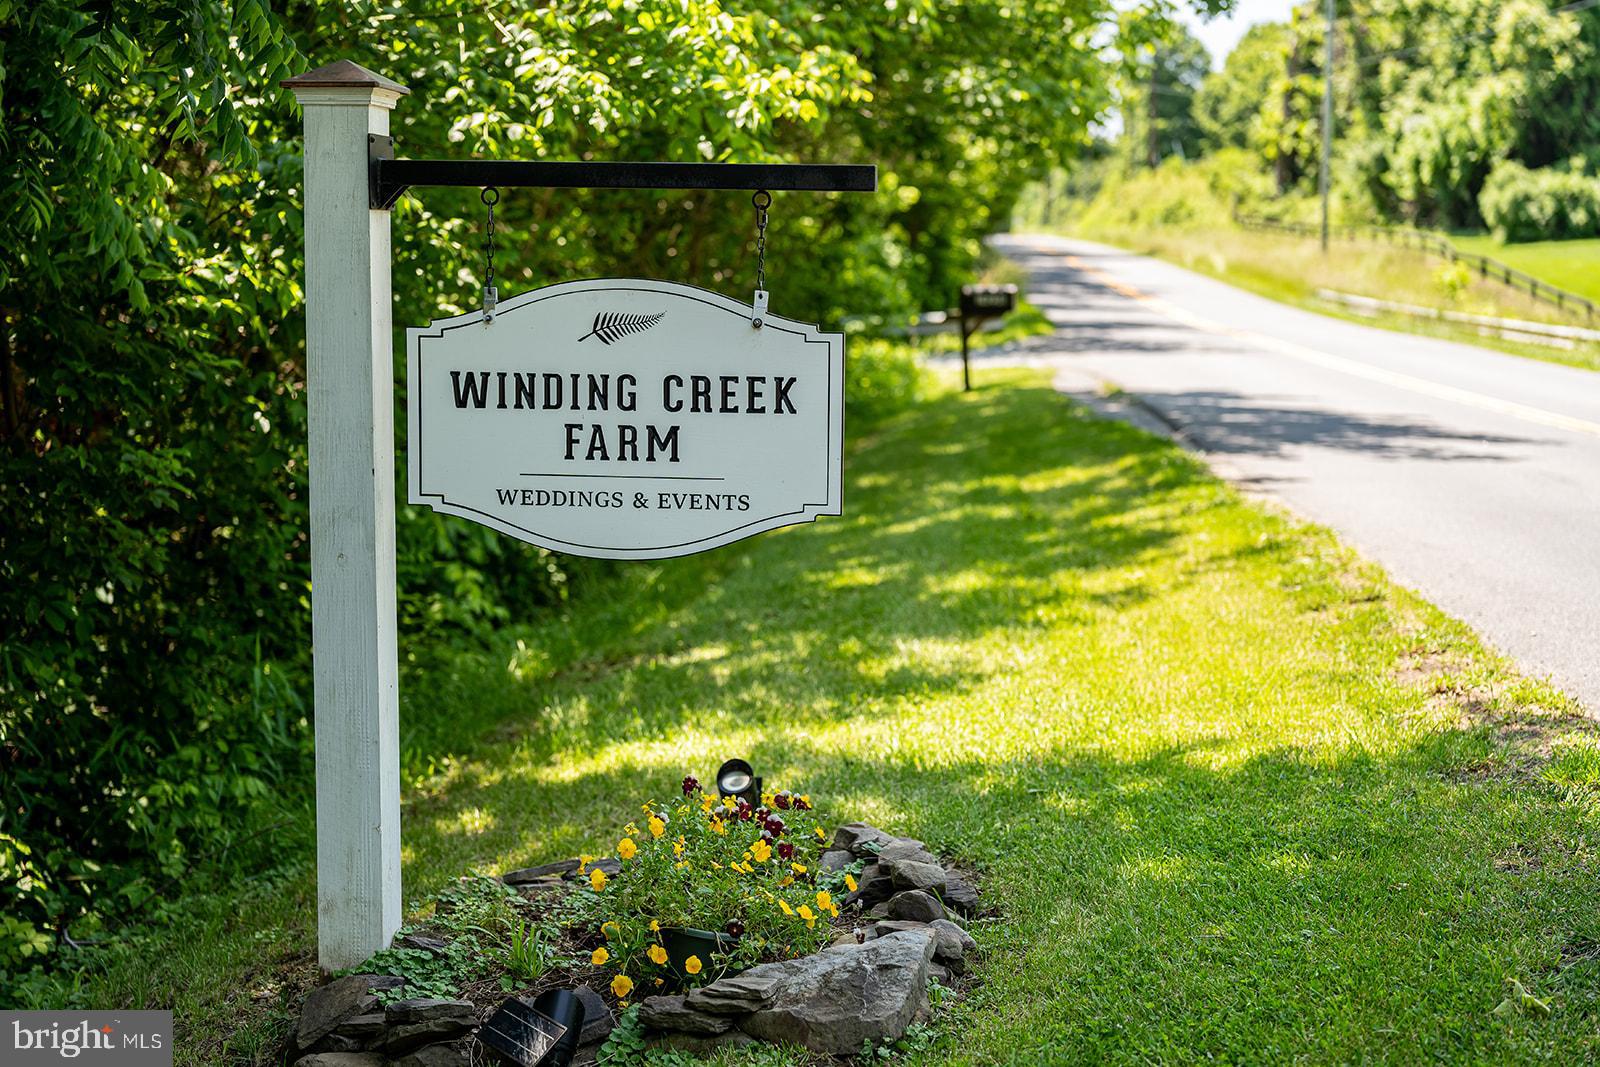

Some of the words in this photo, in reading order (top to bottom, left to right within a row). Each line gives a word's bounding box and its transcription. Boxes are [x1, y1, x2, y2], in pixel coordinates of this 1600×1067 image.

[450, 371, 637, 411] WINDING
[663, 374, 797, 414] CREEK
[564, 423, 681, 462] FARM
[496, 488, 624, 509] WEDDINGS
[632, 491, 649, 510] &
[657, 492, 750, 512] EVENTS
